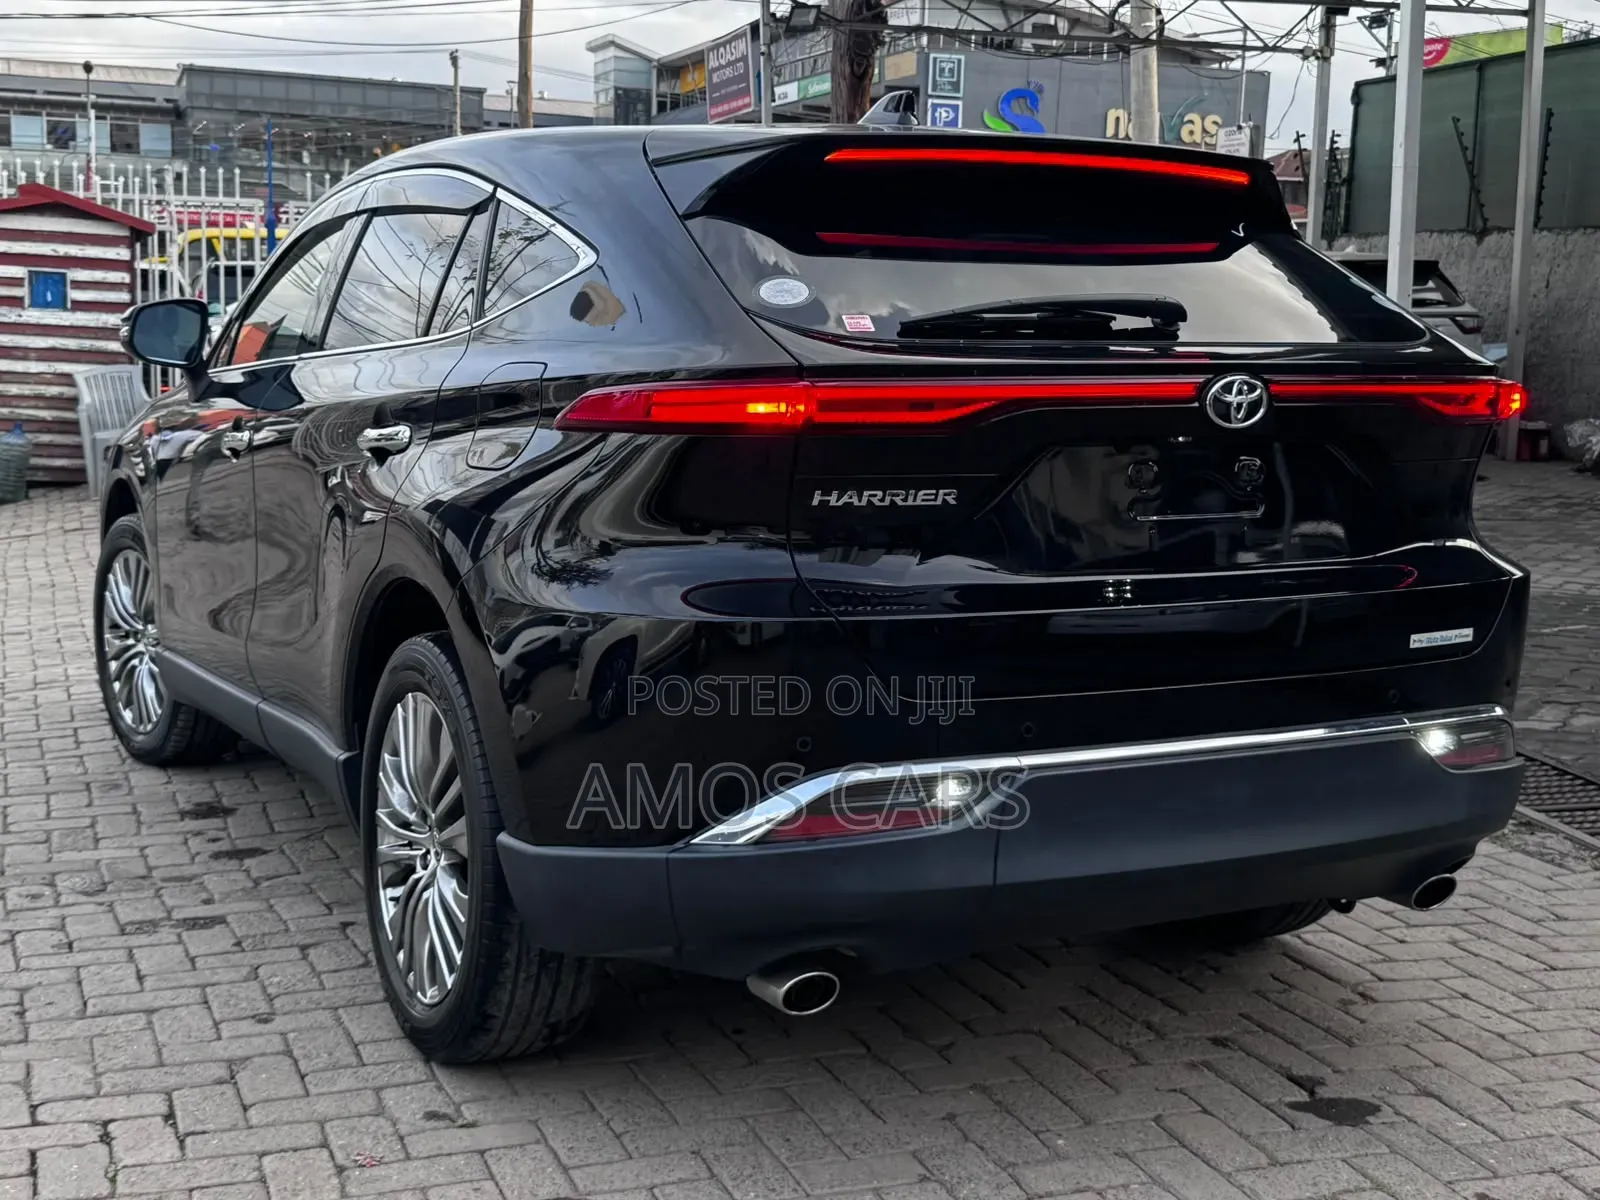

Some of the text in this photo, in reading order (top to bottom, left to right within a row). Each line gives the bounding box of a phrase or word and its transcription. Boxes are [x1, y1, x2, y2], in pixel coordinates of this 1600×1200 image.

[708, 37, 747, 70] ALQASIM
[711, 66, 734, 84] MOTORS
[734, 62, 744, 76] LTD
[1105, 107, 1222, 145] nvas
[811, 489, 958, 507] HARRIER
